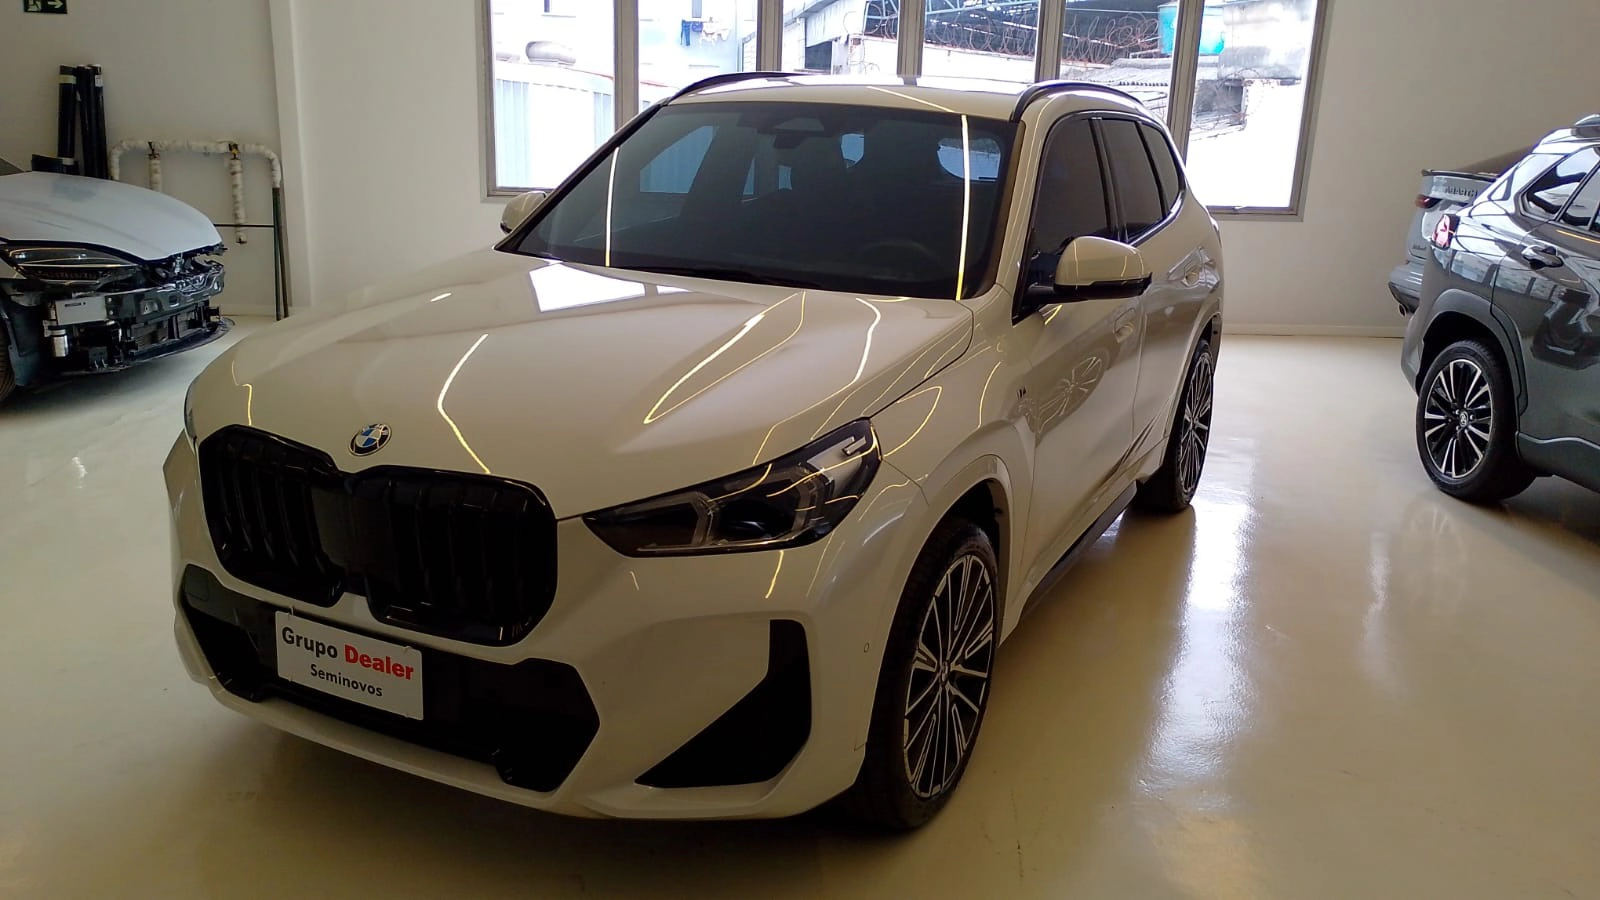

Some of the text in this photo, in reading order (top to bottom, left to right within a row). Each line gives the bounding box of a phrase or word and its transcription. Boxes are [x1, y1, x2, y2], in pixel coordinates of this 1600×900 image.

[282, 626, 414, 681] Grupo Dealer
[310, 663, 383, 697] Seminovos
